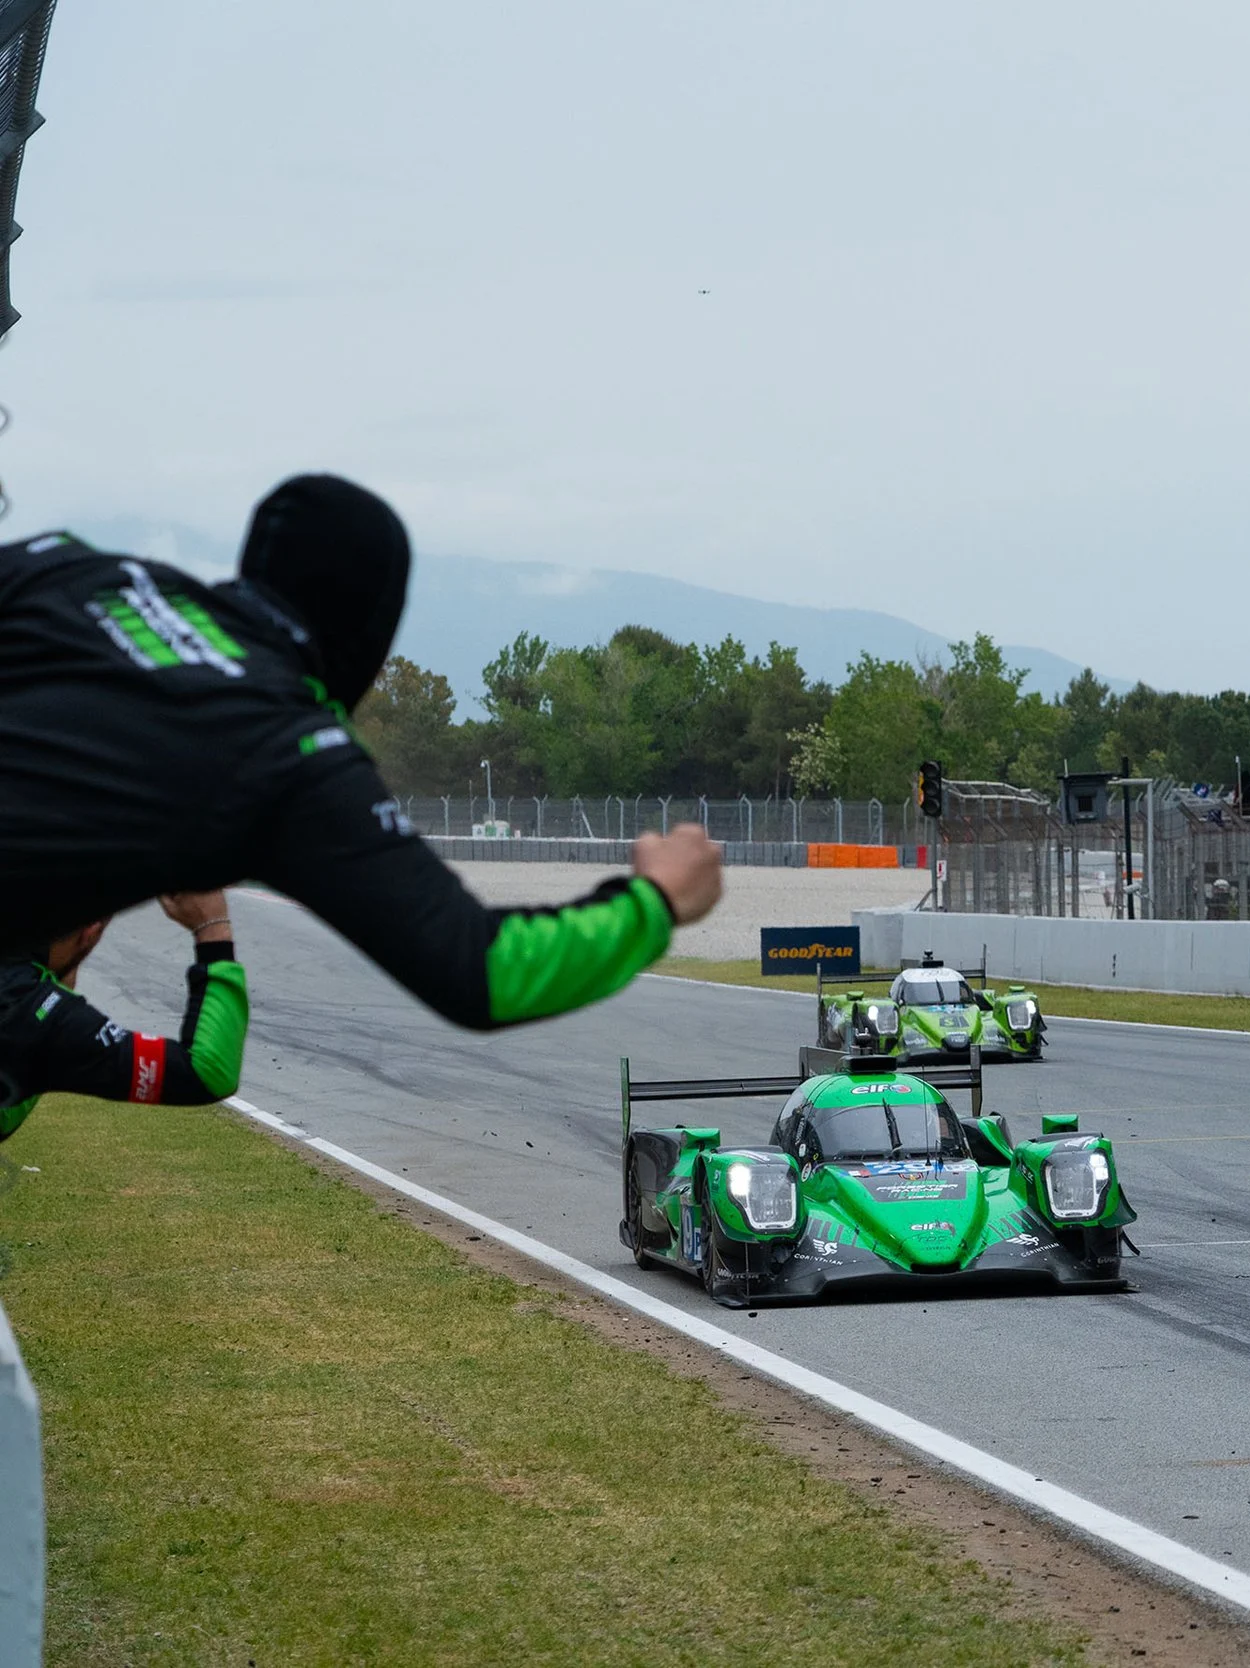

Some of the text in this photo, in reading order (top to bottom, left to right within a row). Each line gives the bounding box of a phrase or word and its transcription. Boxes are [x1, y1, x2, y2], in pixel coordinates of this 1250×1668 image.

[768, 943, 853, 959] GOODYEAR
[851, 1083, 889, 1095] elf
[911, 1223, 937, 1231] elf
[1020, 1241, 1060, 1258] CORINTHIAN
[793, 1253, 844, 1266] CORINTHIAN
